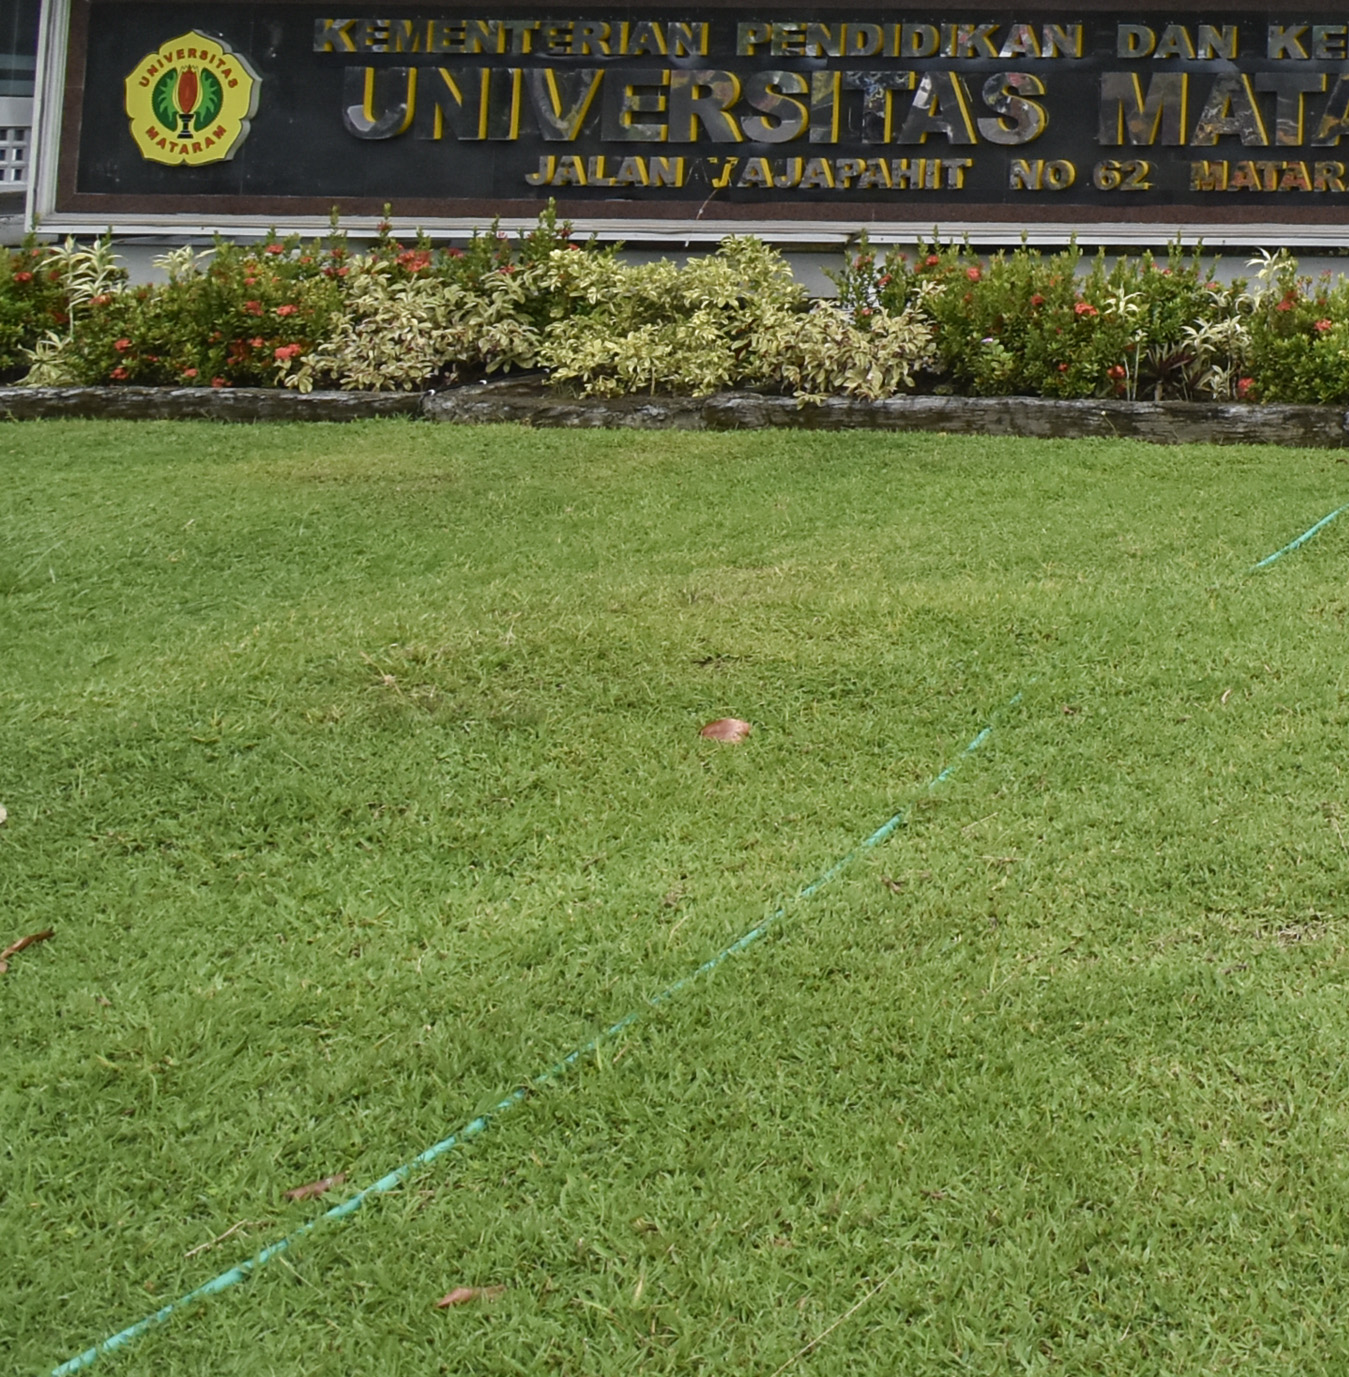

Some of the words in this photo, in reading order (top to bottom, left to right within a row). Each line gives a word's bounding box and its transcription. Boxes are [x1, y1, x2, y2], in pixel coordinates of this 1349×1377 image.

[313, 18, 709, 56] KEMENTERIAN
[736, 22, 1083, 58] PENDIDIKAN
[1116, 24, 1238, 60] DAN
[139, 48, 239, 88] UNIVERSITAS
[343, 66, 1048, 146] UNIVERSITAS
[145, 125, 227, 155] MATARAM
[525, 155, 684, 187] JALAN
[1009, 159, 1077, 191] NO
[1093, 159, 1156, 191] 62
